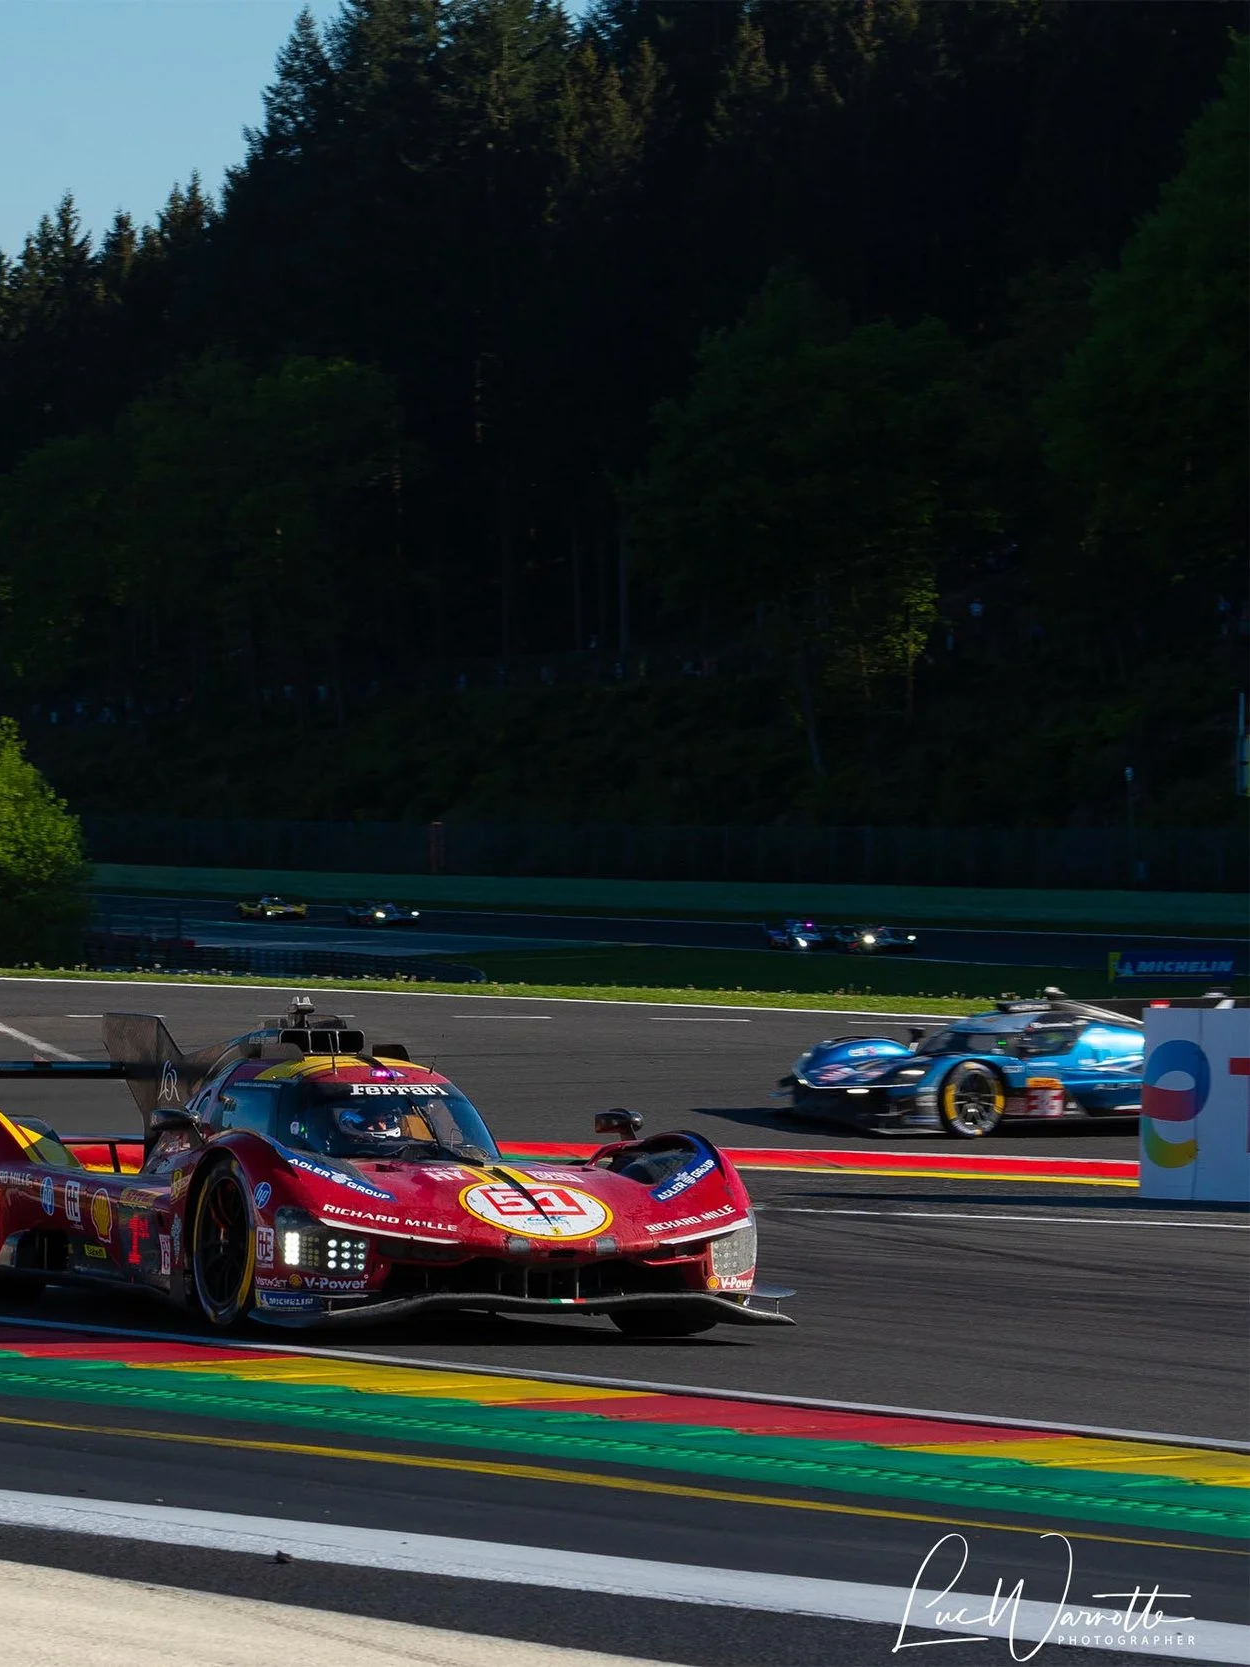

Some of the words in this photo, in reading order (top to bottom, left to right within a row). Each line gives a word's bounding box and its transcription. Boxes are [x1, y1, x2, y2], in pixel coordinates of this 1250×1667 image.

[1136, 961, 1234, 973] MICHELIN
[350, 1084, 449, 1096] Ferrari
[288, 1158, 330, 1179] ADLER
[346, 1180, 391, 1200] GROUP
[255, 1183, 271, 1208] hp
[656, 1180, 688, 1201] ADLER
[486, 1191, 581, 1213] 51
[323, 1203, 400, 1225] RICHARD
[405, 1218, 458, 1232] MILLE
[645, 1216, 702, 1232] RICHARD
[700, 1204, 736, 1223] MILLE
[304, 1276, 368, 1289] V-Power
[270, 1297, 314, 1306] MICHELIN
